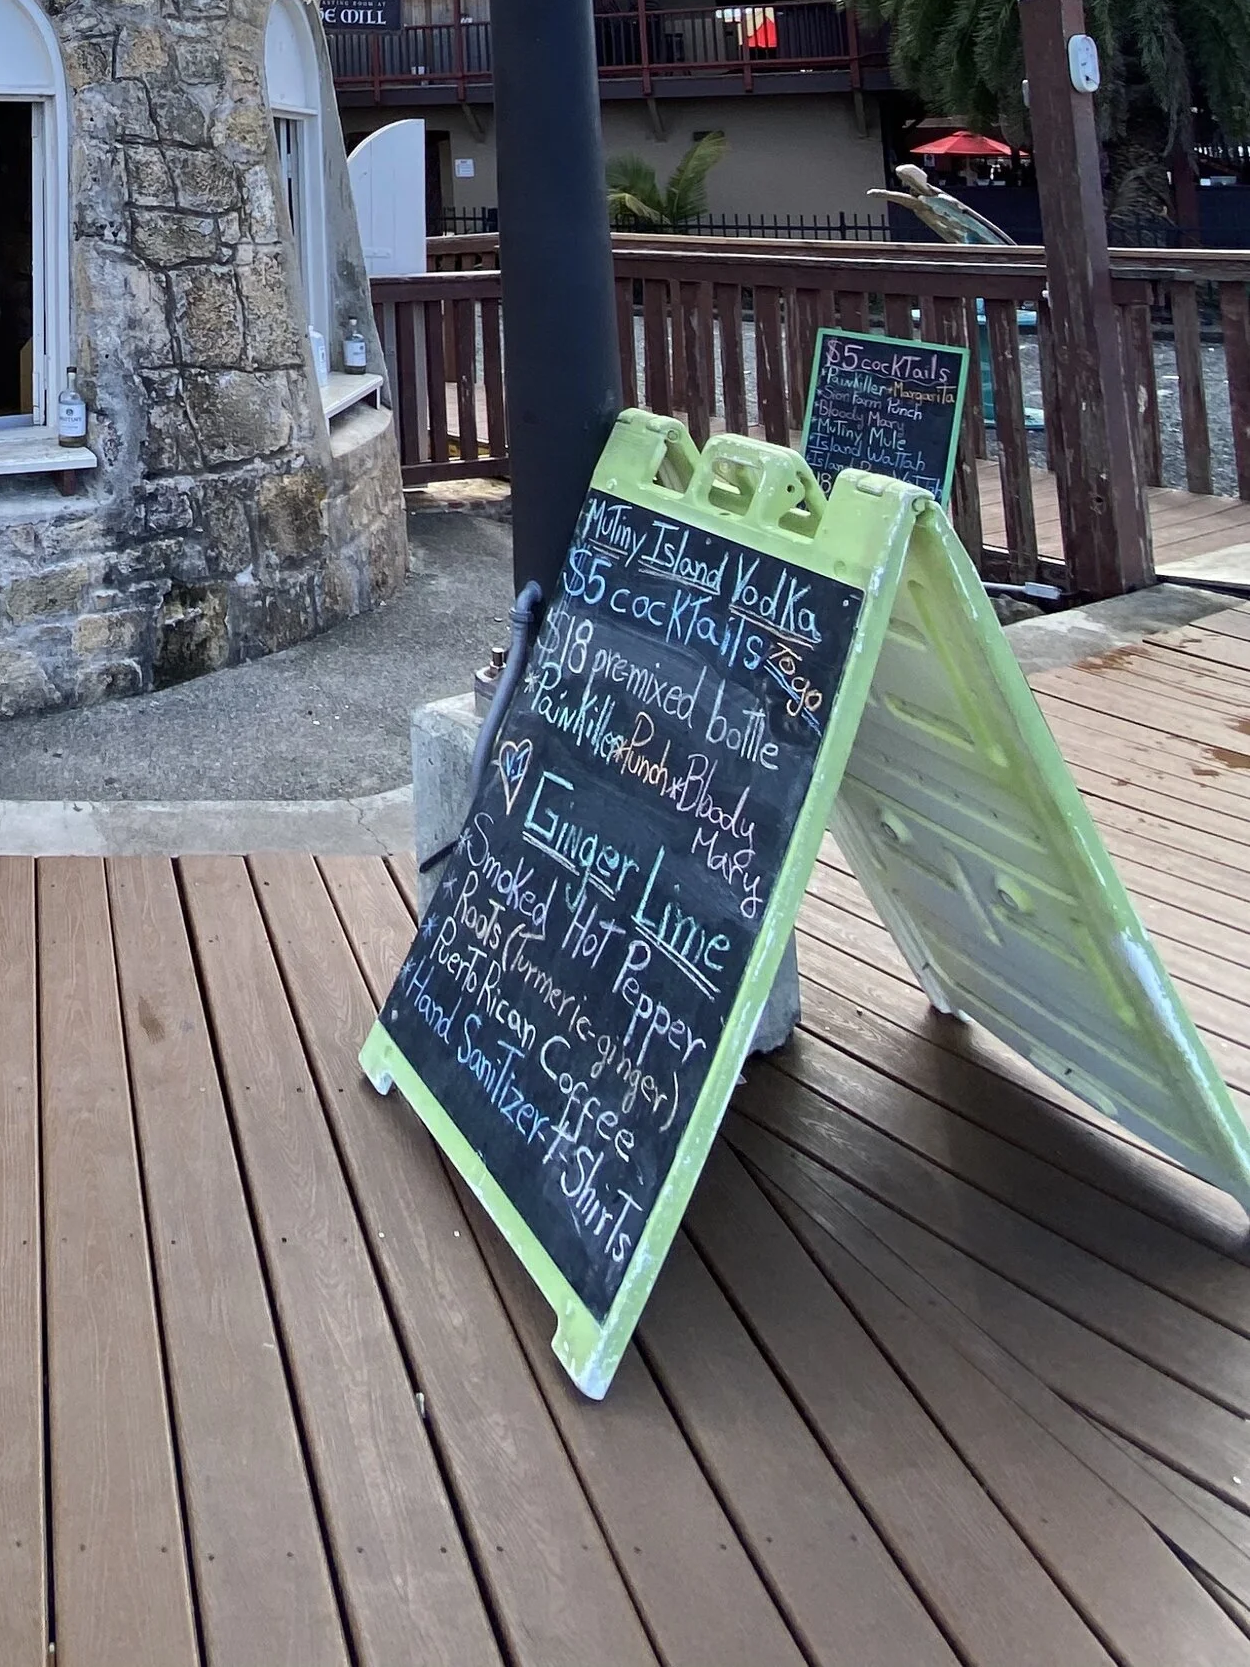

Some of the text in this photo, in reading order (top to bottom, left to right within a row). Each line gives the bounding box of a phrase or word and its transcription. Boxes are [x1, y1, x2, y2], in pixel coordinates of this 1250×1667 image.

[340, 8, 387, 25] MILL
[825, 337, 864, 370] $5
[818, 399, 905, 437] Bloody Mary
[852, 390, 882, 409] Farm
[886, 397, 923, 421] Punch
[869, 427, 907, 451] Mule
[807, 432, 861, 457] Island
[562, 539, 613, 606] $5
[641, 520, 729, 589] Island
[537, 606, 594, 674] $18
[768, 641, 803, 676] To
[785, 675, 824, 718] go
[619, 711, 673, 797] Punch
[676, 752, 756, 868] Bloody
[690, 827, 764, 919] Mary
[633, 845, 731, 971] Lime
[405, 956, 463, 1046] Hand
[612, 939, 707, 1065] Pepper
[477, 959, 537, 1050] Rican
[539, 1034, 636, 1163] Coffee
